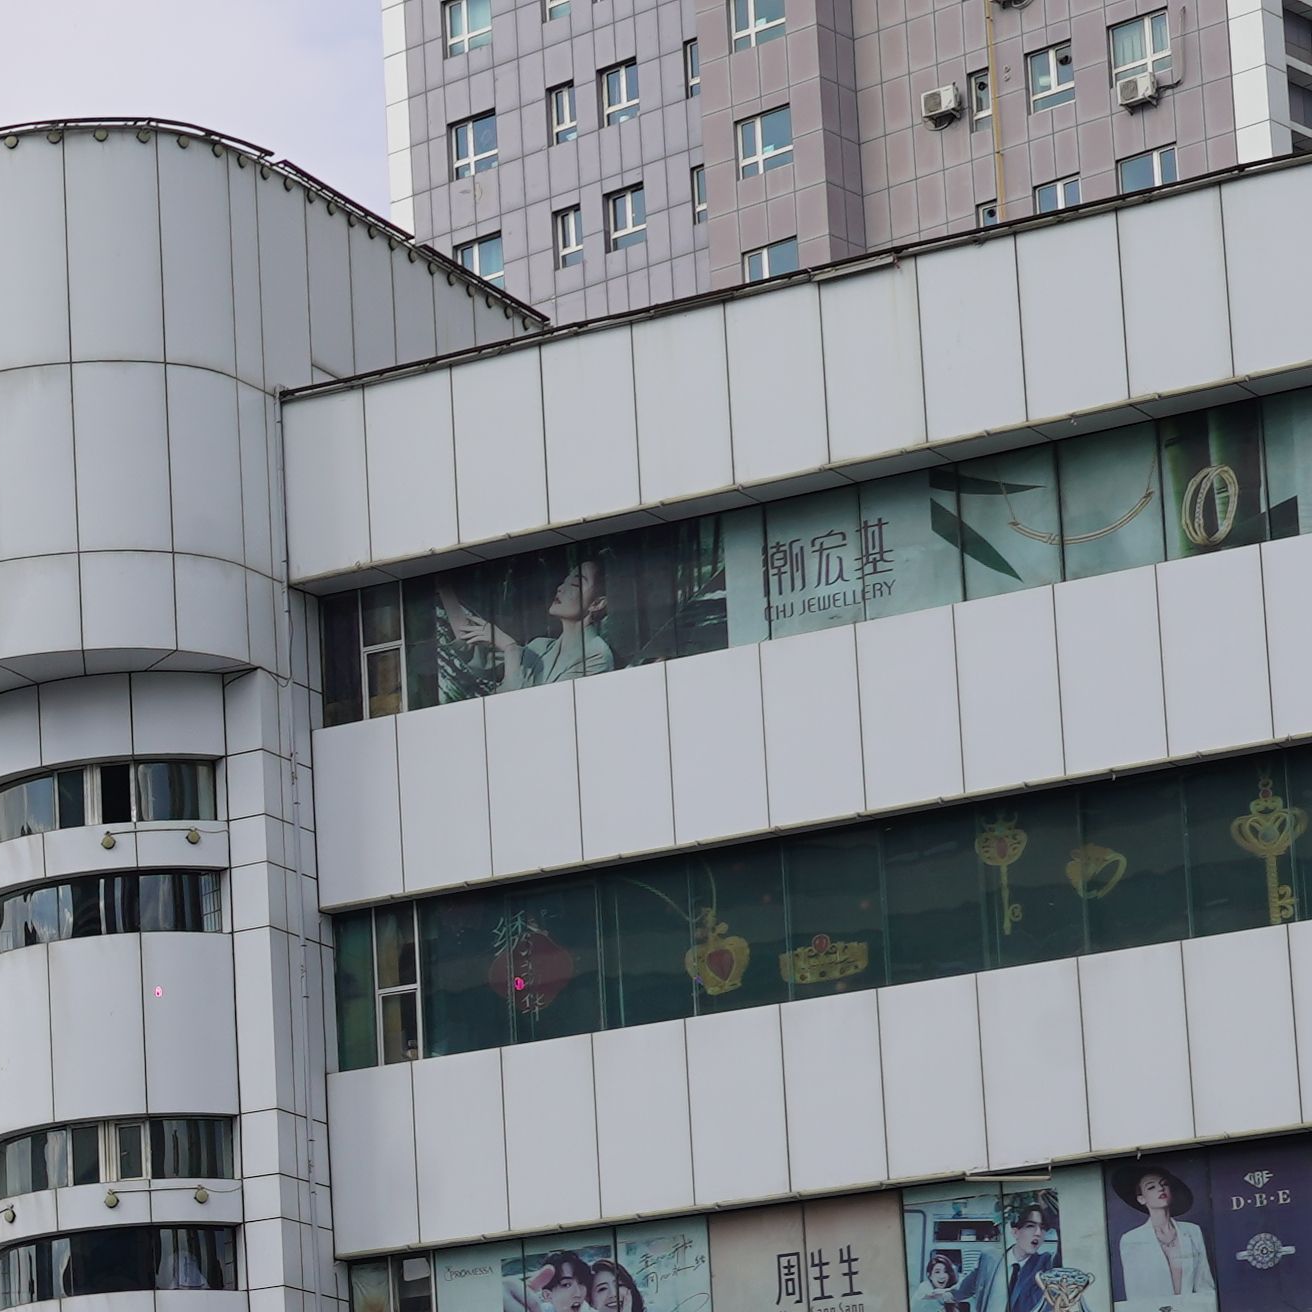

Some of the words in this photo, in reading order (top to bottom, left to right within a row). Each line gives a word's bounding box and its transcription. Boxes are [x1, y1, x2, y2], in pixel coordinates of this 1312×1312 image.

[761, 517, 894, 598] 潮宏基
[764, 602, 794, 622] CHJ
[798, 579, 896, 617] JEWELLERY
[776, 1244, 864, 1305] 周生生
